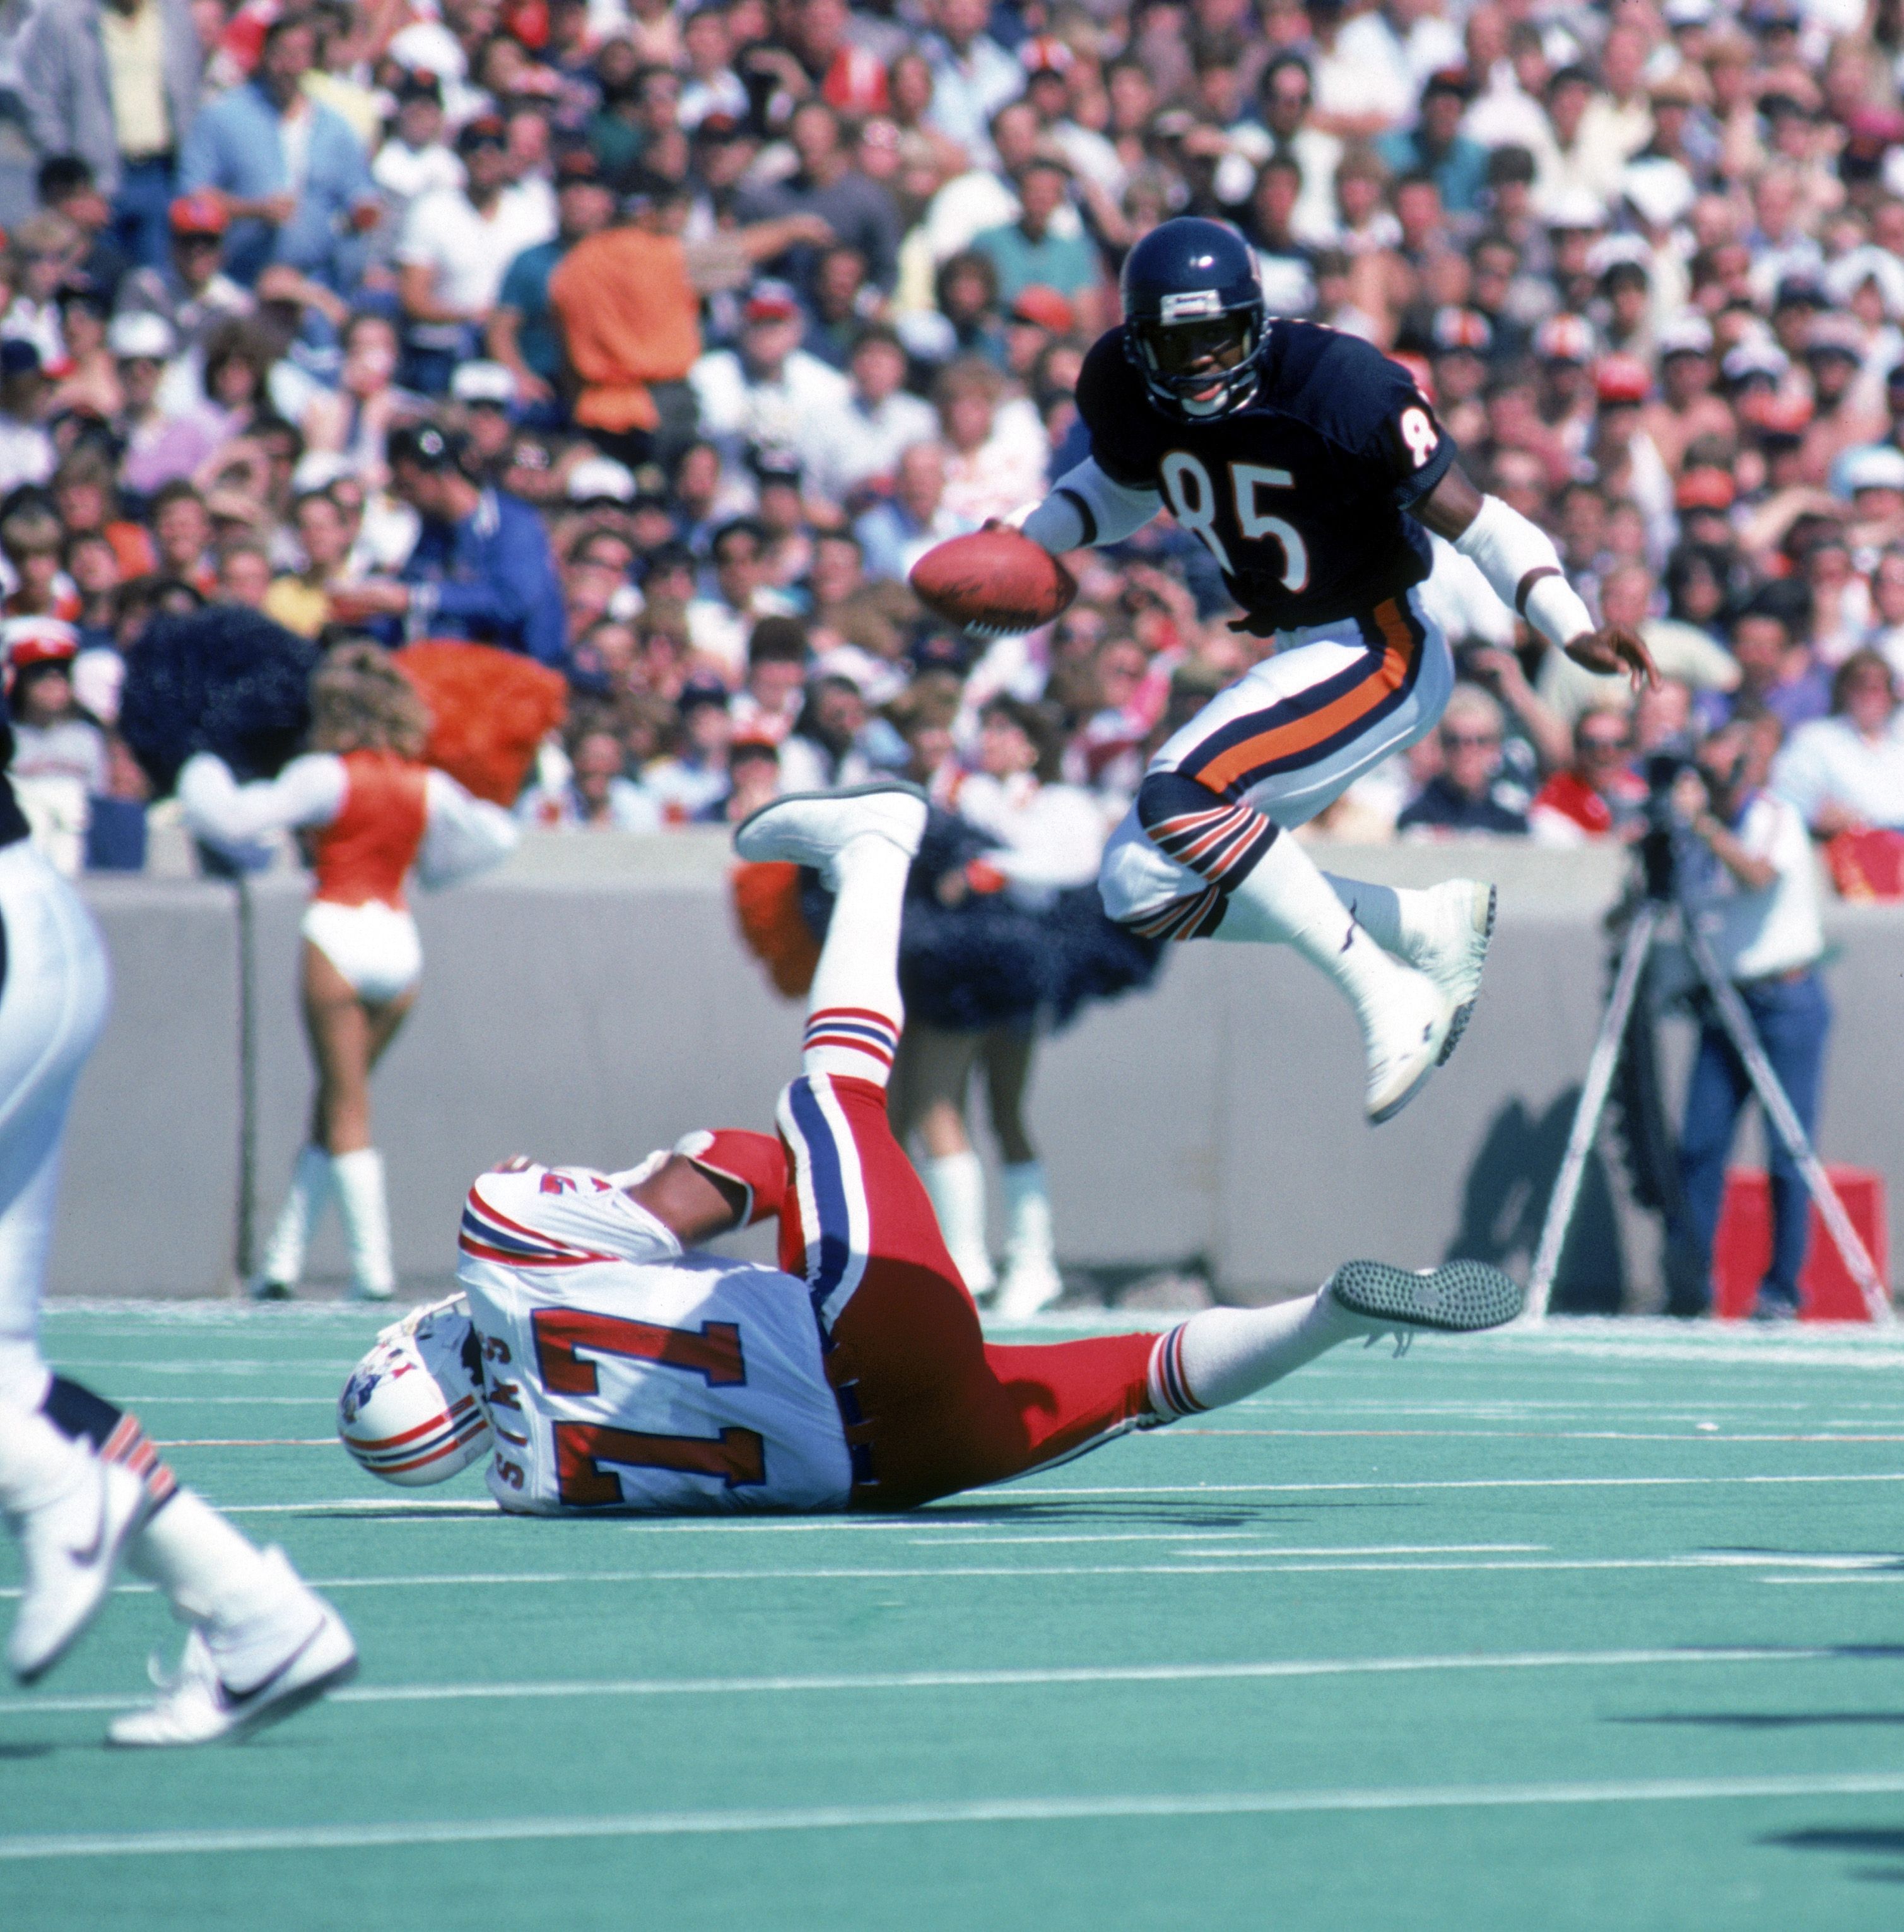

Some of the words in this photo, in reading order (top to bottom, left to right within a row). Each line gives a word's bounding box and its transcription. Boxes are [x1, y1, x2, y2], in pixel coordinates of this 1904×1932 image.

[1159, 449, 1310, 594] 85
[478, 1332, 527, 1490] SIMS
[530, 1306, 766, 1506] 77
